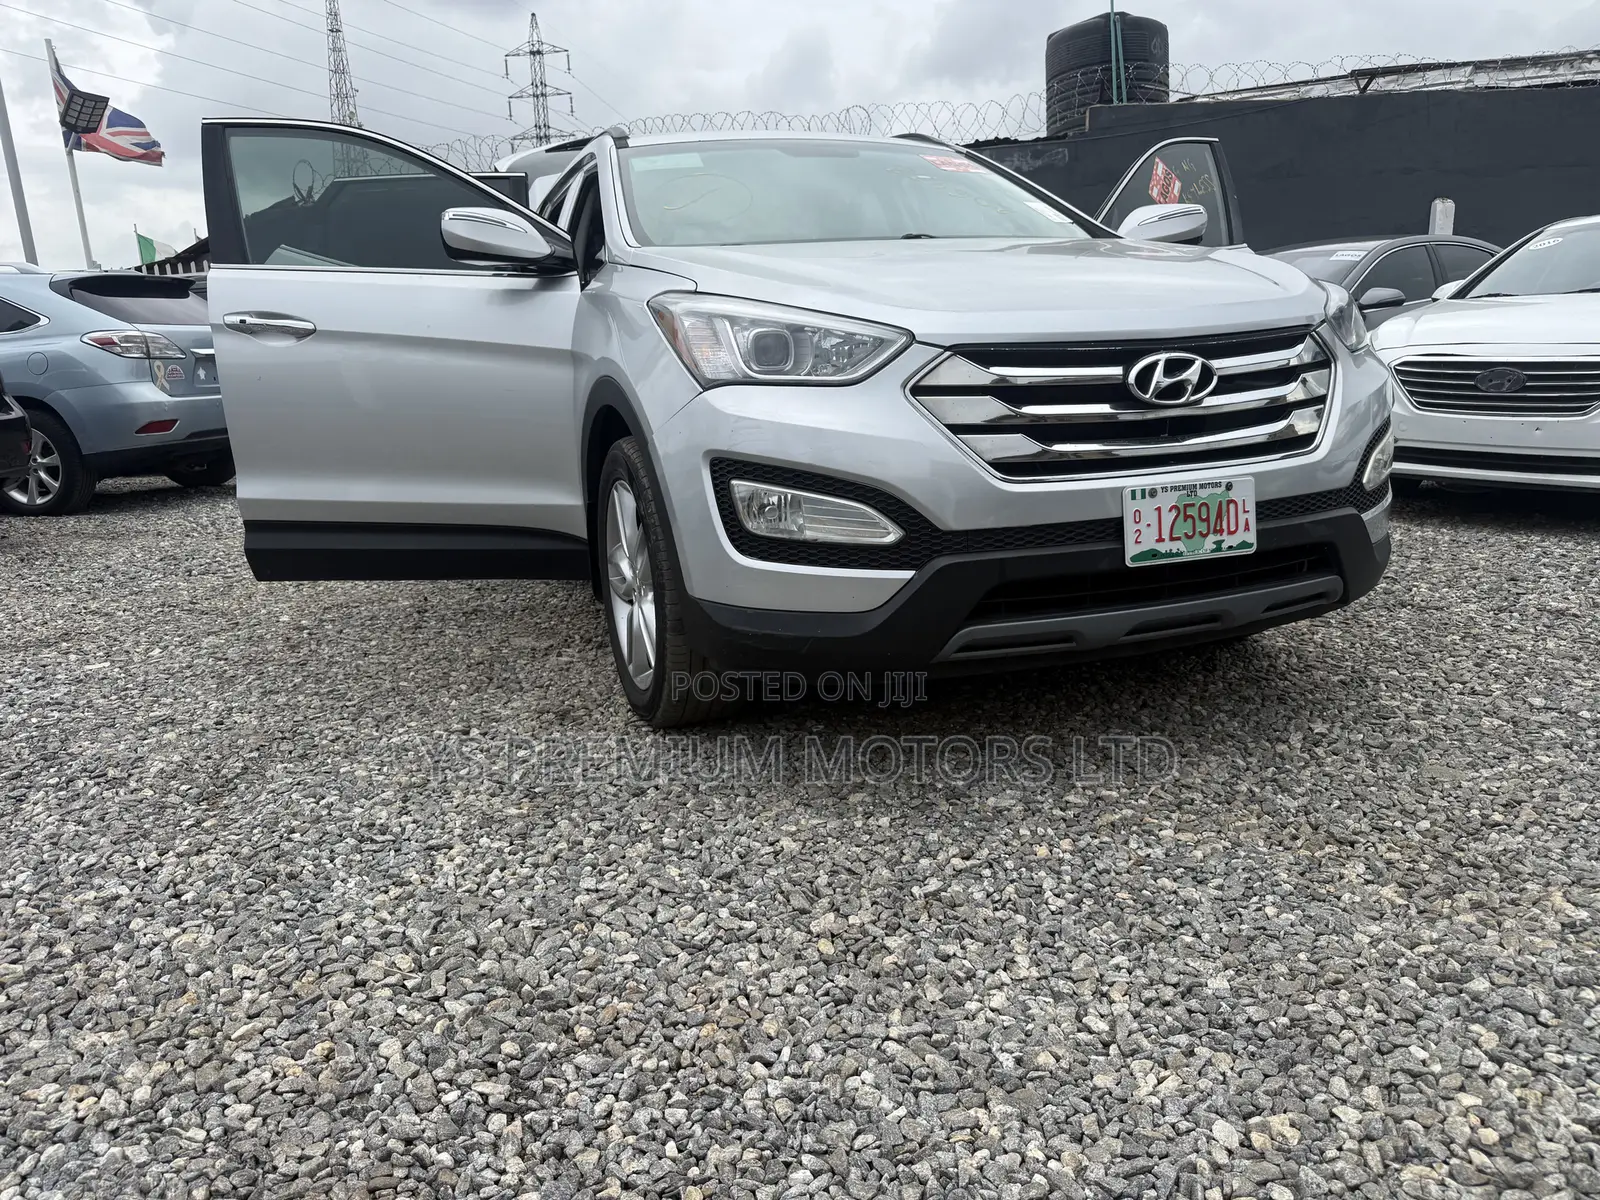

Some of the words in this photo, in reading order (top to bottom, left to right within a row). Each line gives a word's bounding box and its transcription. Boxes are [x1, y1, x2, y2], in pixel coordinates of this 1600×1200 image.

[1160, 485, 1169, 493] YS
[1170, 482, 1198, 493] PREMIUM
[1198, 481, 1223, 490] MOTORS
